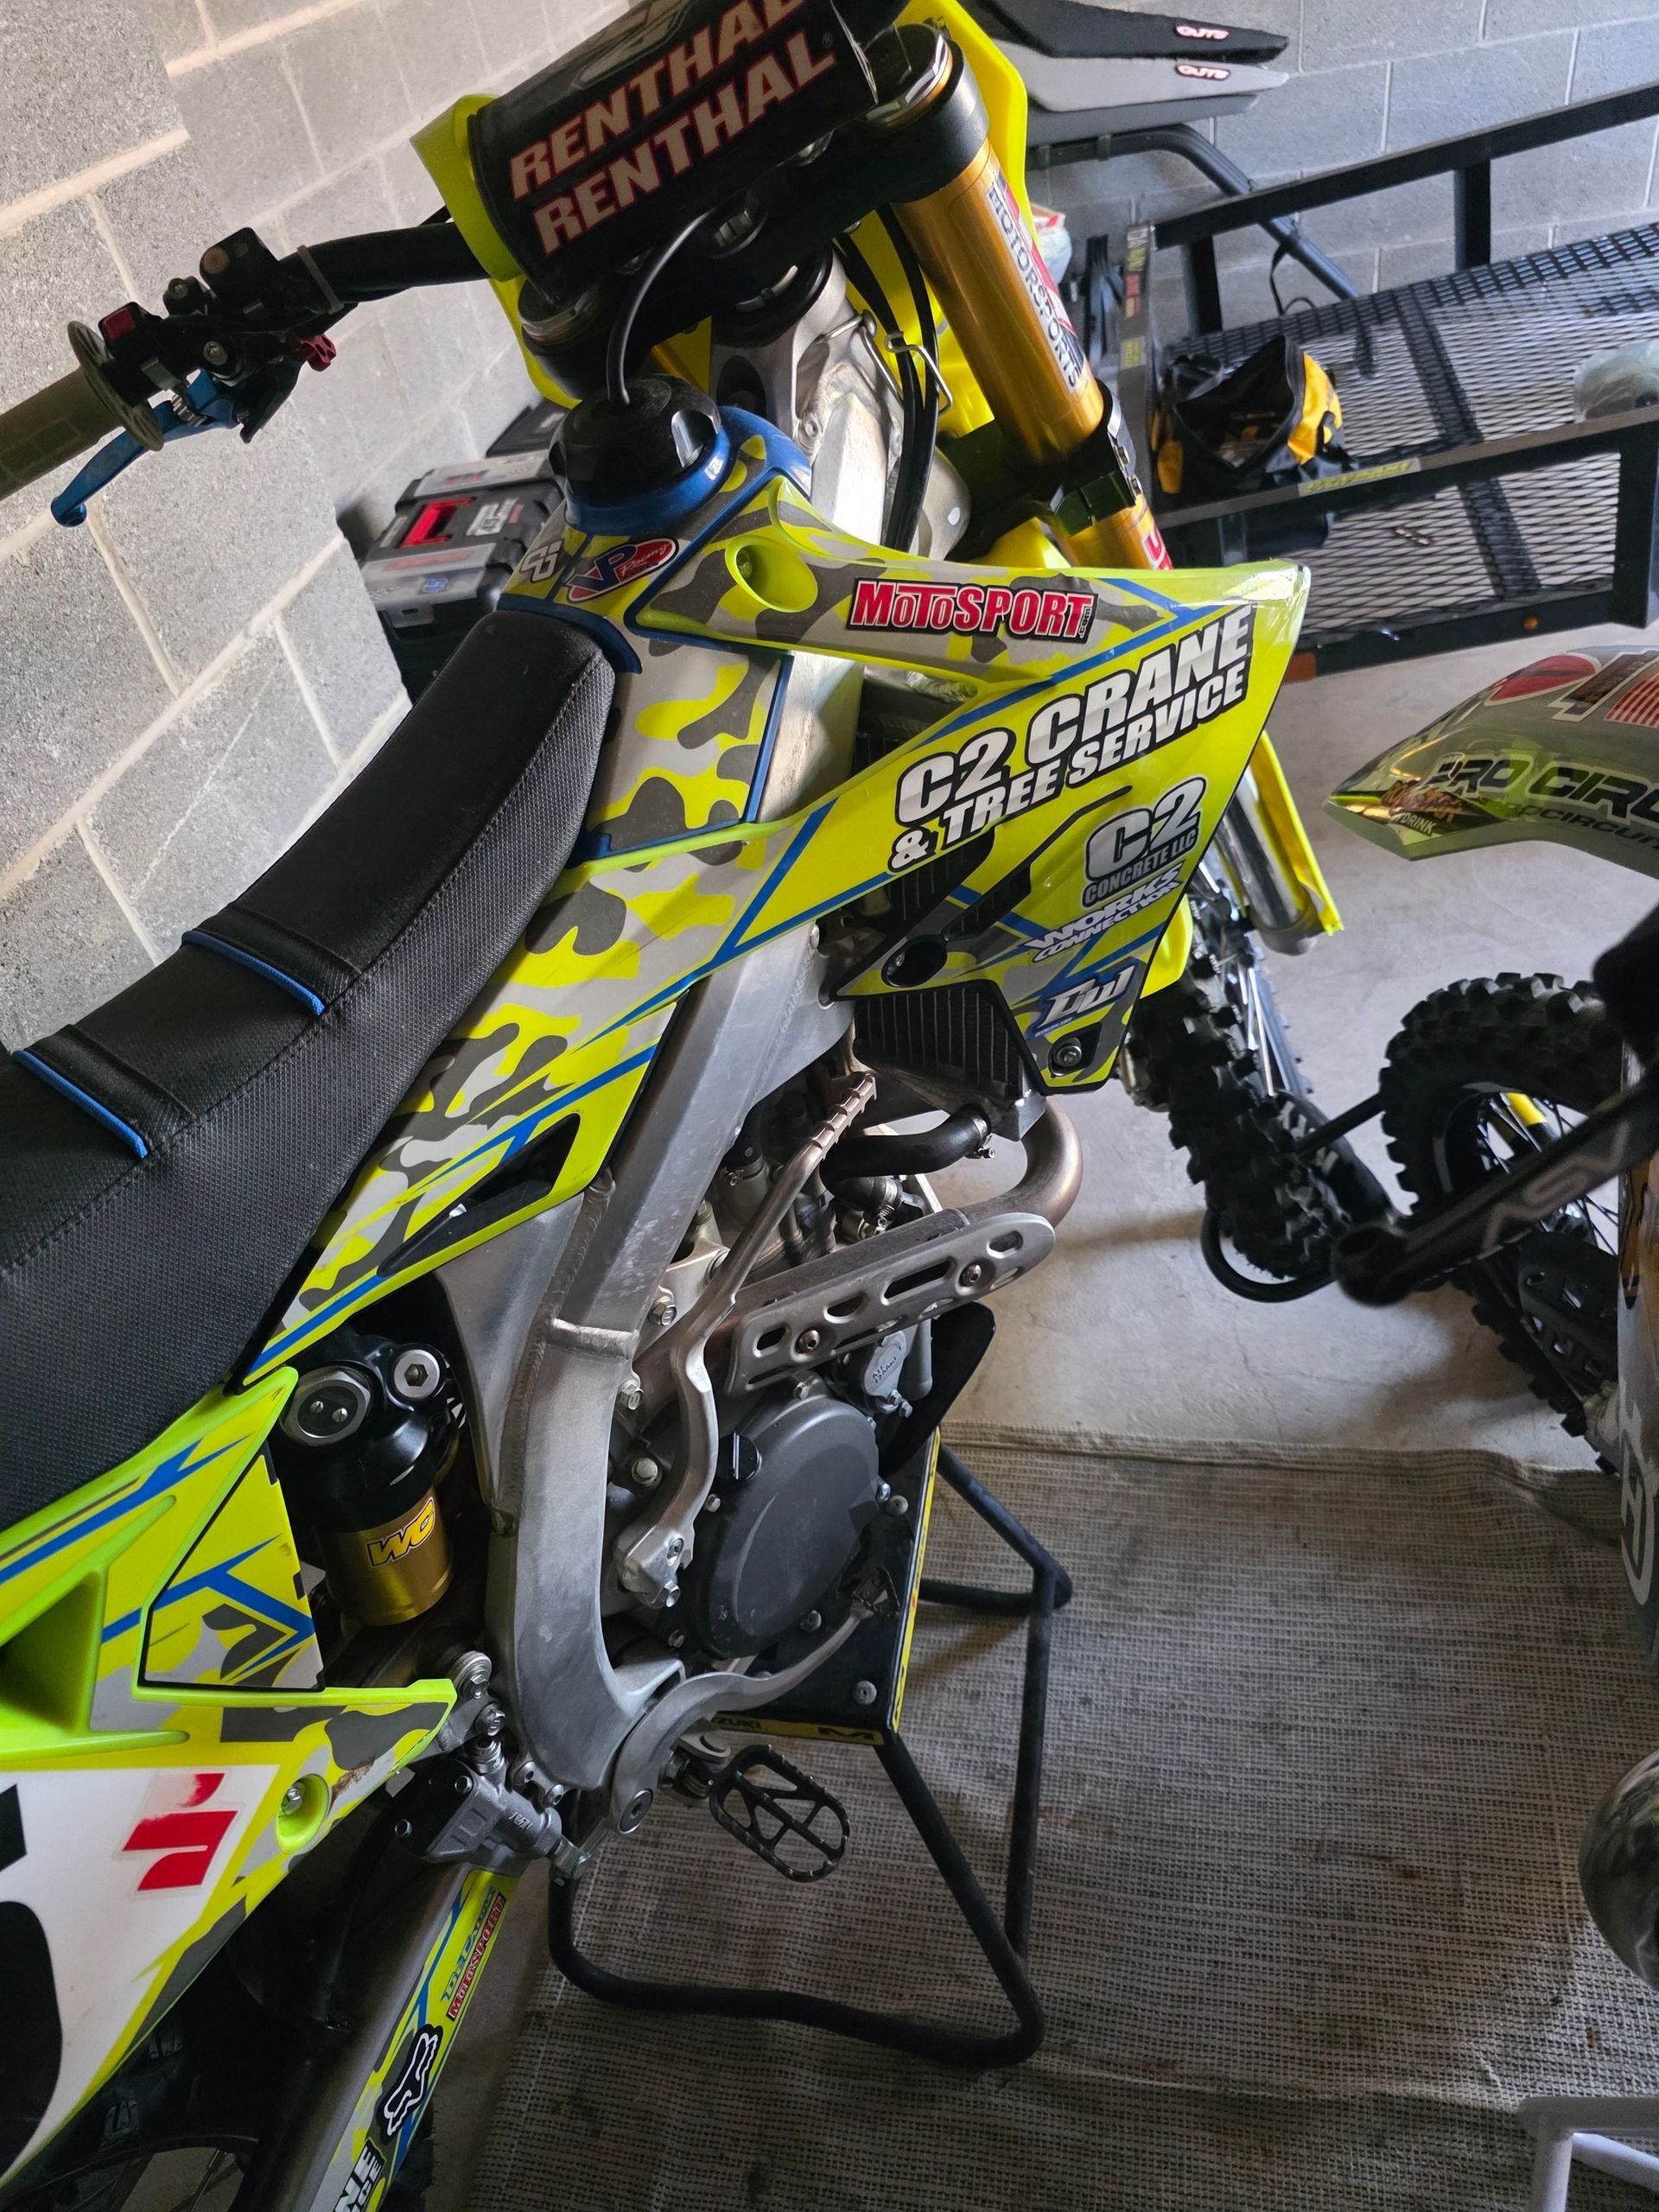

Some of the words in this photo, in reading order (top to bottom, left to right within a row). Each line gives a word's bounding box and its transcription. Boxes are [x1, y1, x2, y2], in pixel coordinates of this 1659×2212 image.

[531, 31, 836, 256] RENTHAL
[988, 183, 1081, 388] MOTORSPORTS
[889, 827, 930, 871] &
[942, 760, 1063, 847] TREE
[1065, 664, 1250, 787] SERVICE
[896, 730, 1014, 823] C2
[1026, 602, 1256, 766] CRANE
[1023, 861, 1185, 950] WORKS
[1084, 849, 1169, 906] CONCRETE
[1168, 827, 1199, 858] LLC
[1086, 777, 1206, 880] C2
[1033, 880, 1182, 963] CONNECTION
